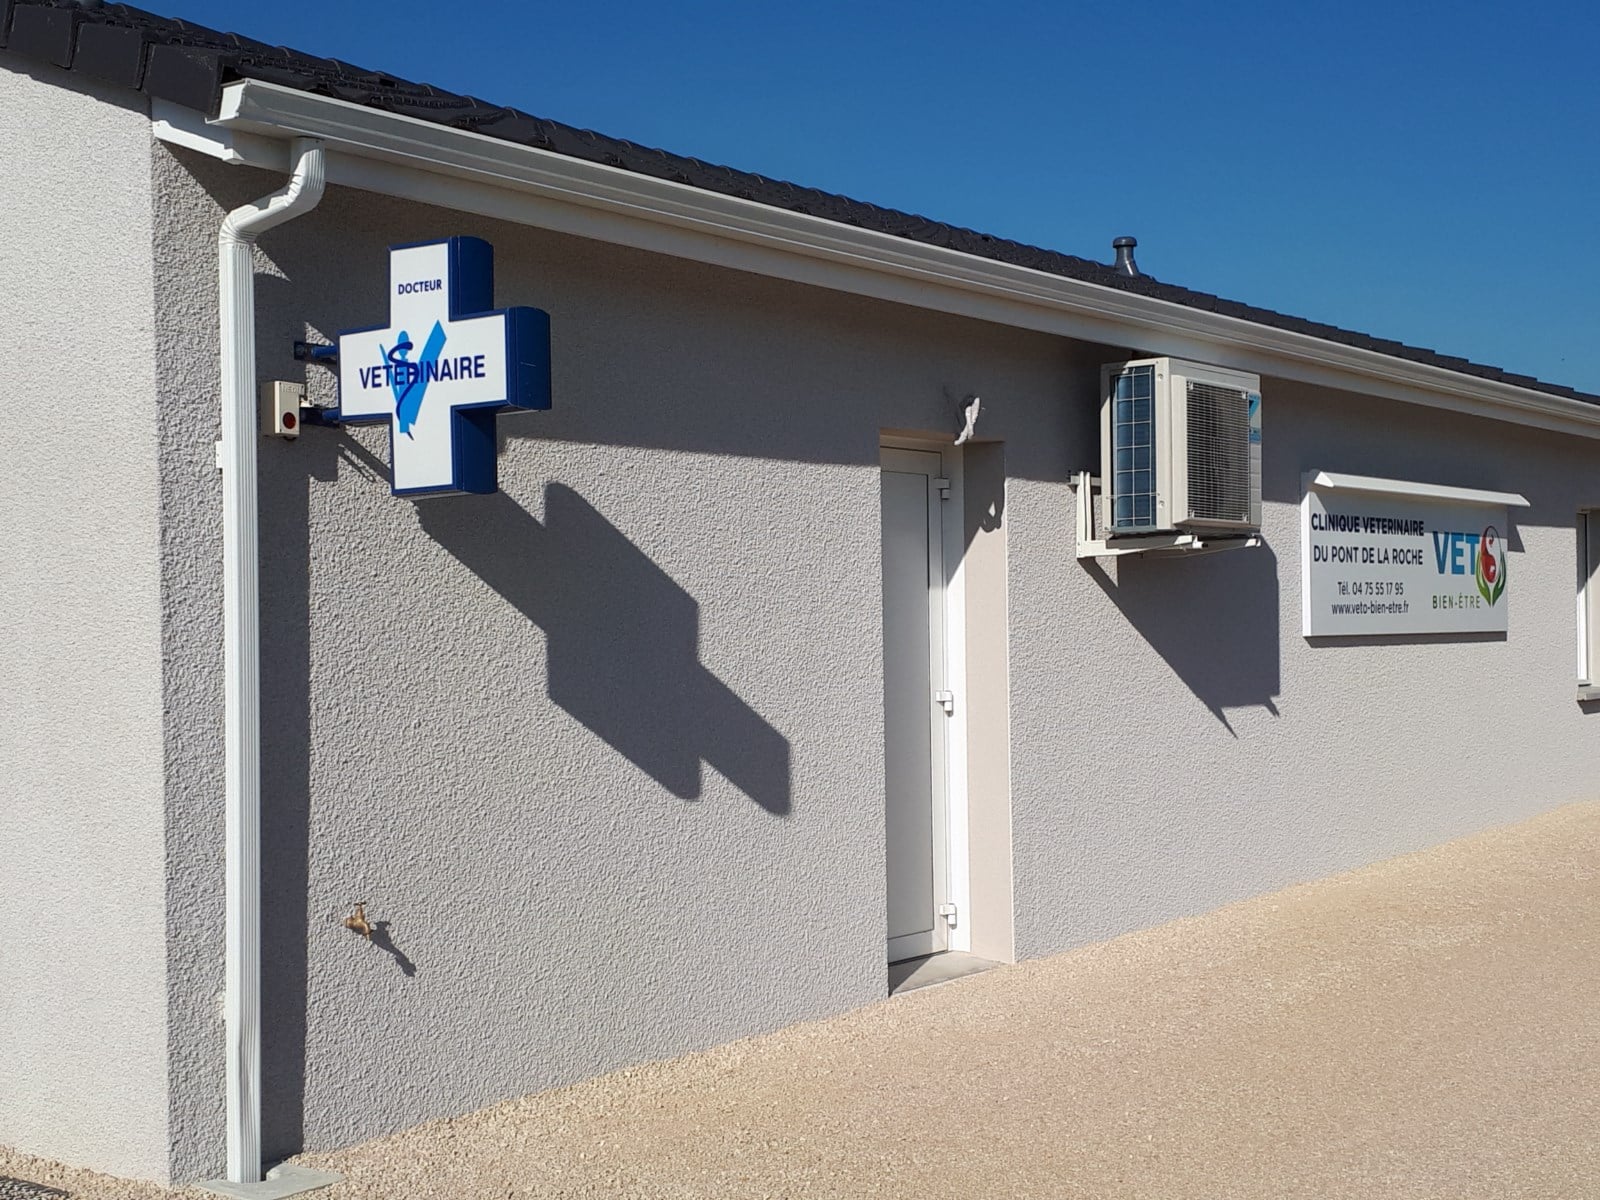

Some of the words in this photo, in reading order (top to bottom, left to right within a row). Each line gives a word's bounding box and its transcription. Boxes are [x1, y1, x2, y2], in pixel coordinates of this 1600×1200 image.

[398, 279, 442, 295] DOCTEUR
[359, 355, 486, 389] VETERINAIRE
[1311, 513, 1360, 533] CLINIQUE
[1363, 516, 1424, 536] VETERINAIRE
[1313, 545, 1328, 562] DU
[1331, 546, 1359, 563] PONT
[1362, 547, 1375, 564] DE
[1377, 548, 1390, 564] LA
[1392, 548, 1424, 565] ROCHE
[1352, 582, 1362, 596] 04
[1365, 582, 1374, 596] 75
[1375, 582, 1384, 596] 55
[1386, 582, 1393, 595] 17
[1395, 582, 1404, 596] 95
[1331, 600, 1409, 615] www.veto-bien-etre.fr
